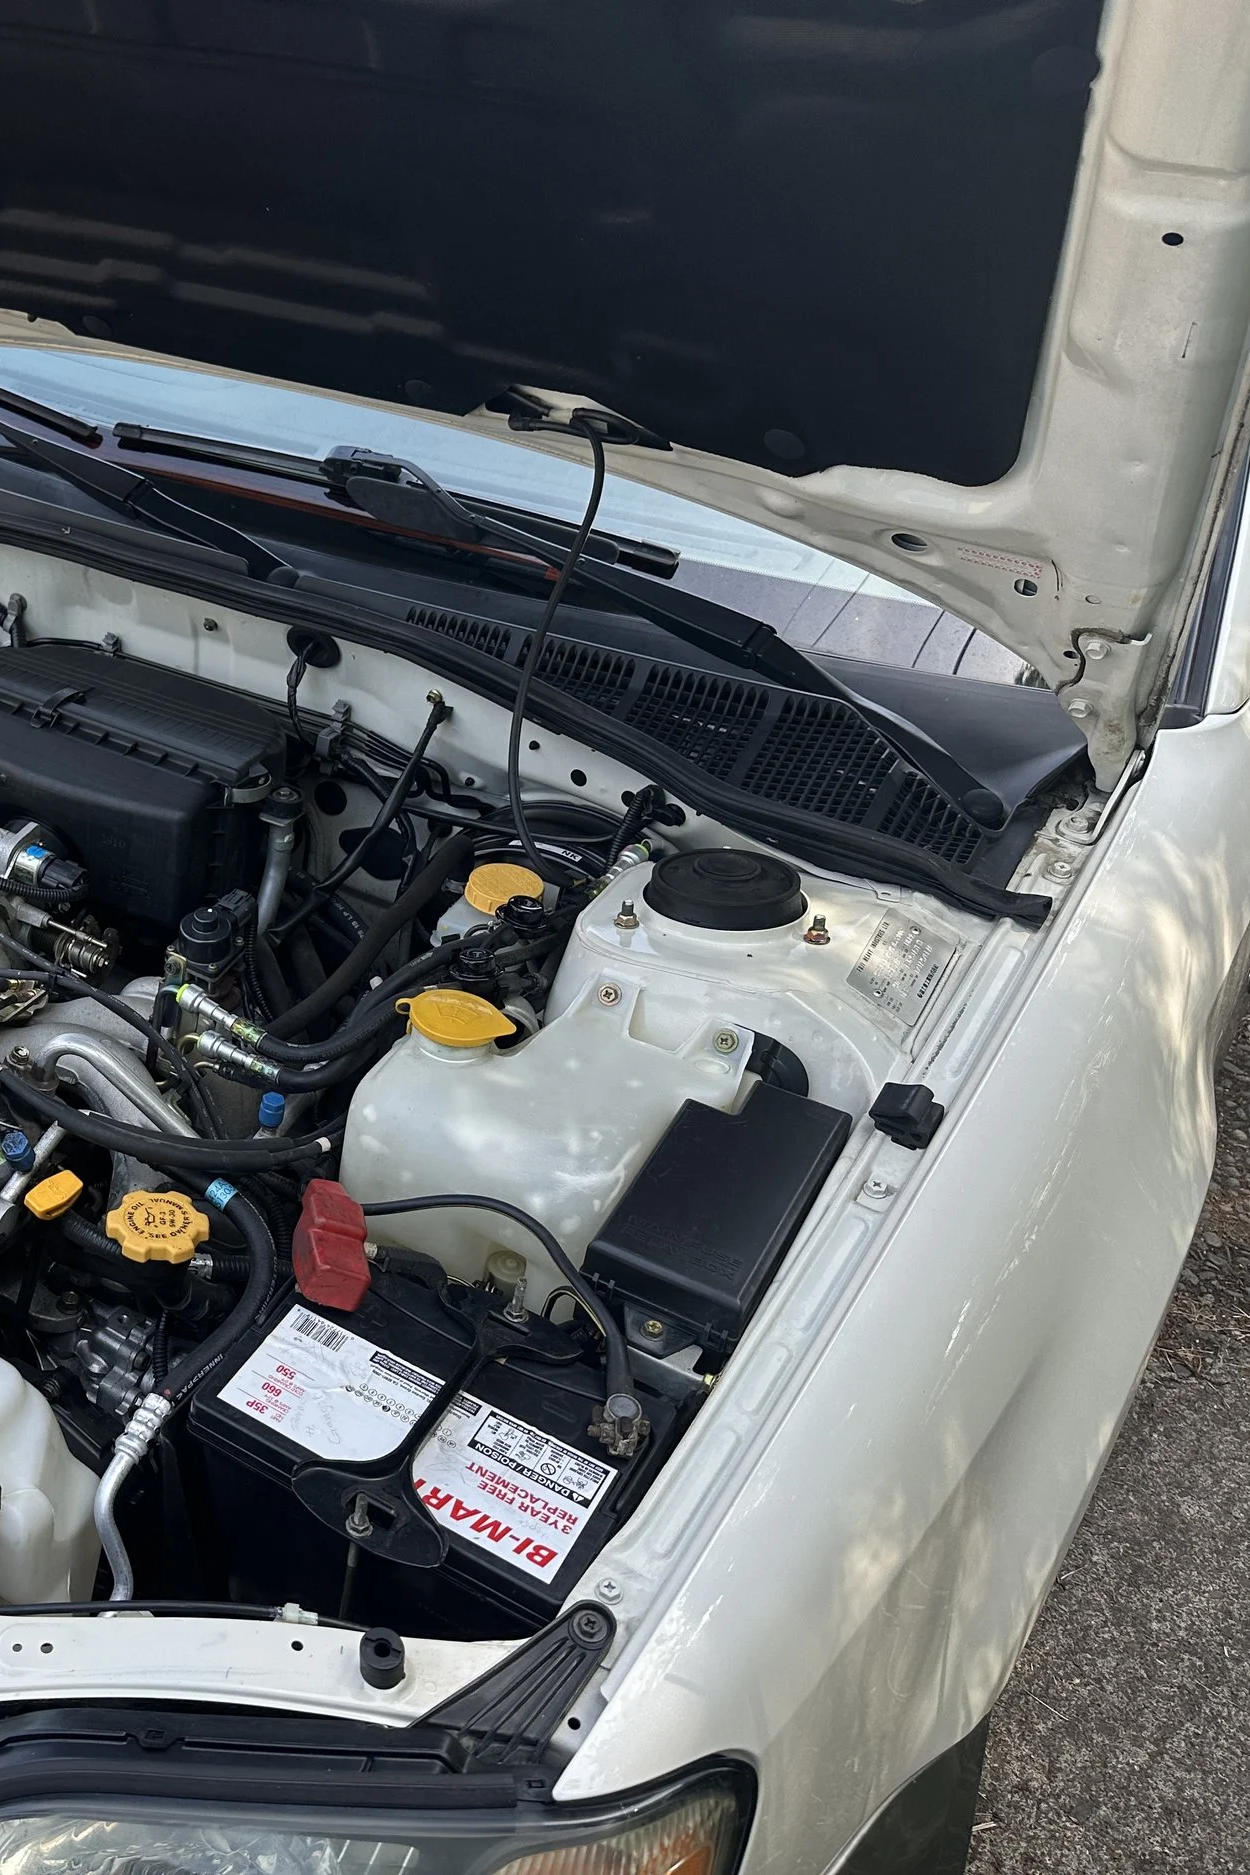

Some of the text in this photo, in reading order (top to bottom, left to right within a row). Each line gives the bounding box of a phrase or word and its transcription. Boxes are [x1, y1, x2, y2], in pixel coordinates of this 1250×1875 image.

[562, 850, 580, 862] NK
[149, 1198, 184, 1211] MANUAL
[127, 1201, 145, 1235] ENGINE OIL
[274, 1364, 297, 1379] 550
[260, 1381, 283, 1396] 660
[244, 1397, 269, 1414] 35P
[474, 1442, 517, 1469] POISON
[464, 1460, 578, 1525] REPLACEMENT
[476, 1479, 516, 1505] FREE
[521, 1467, 570, 1497] DANGER
[517, 1500, 560, 1529] YEAR
[560, 1523, 572, 1535] 3
